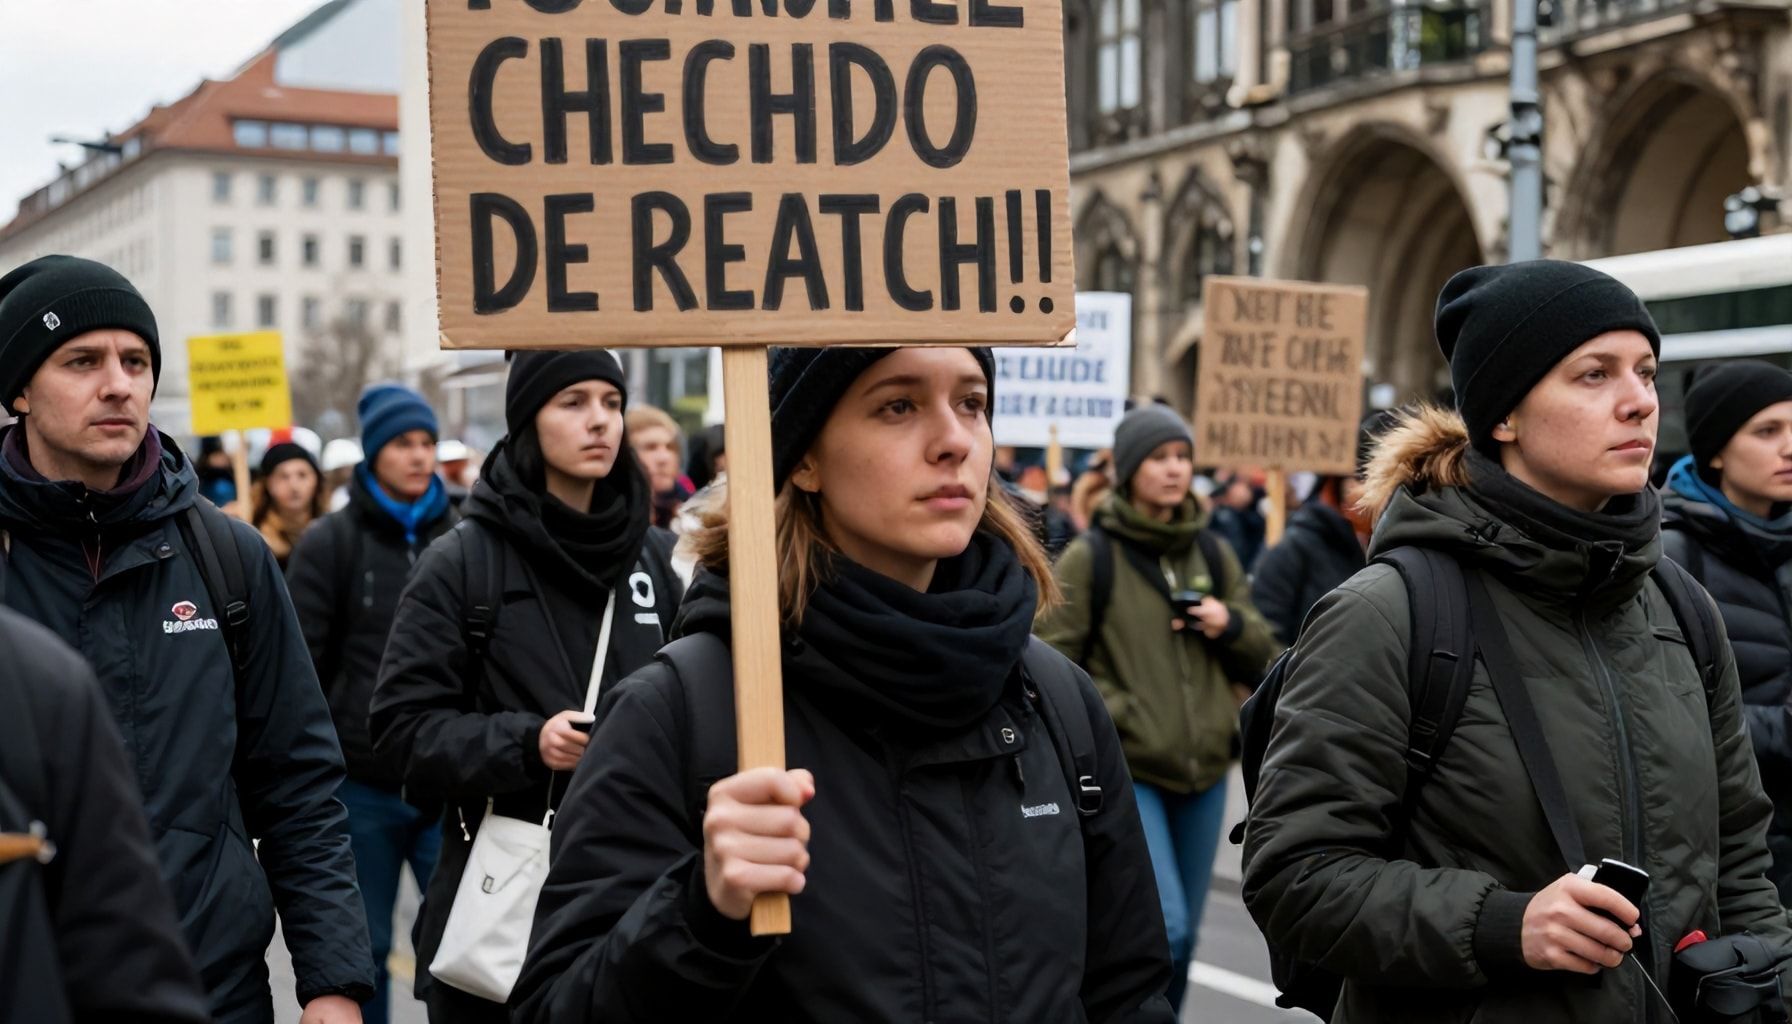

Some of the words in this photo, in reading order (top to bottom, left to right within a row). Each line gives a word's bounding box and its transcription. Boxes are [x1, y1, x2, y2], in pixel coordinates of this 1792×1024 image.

[468, 36, 978, 169] CHECHDO
[469, 192, 600, 316] DE
[631, 189, 1054, 315] REATCH!!
